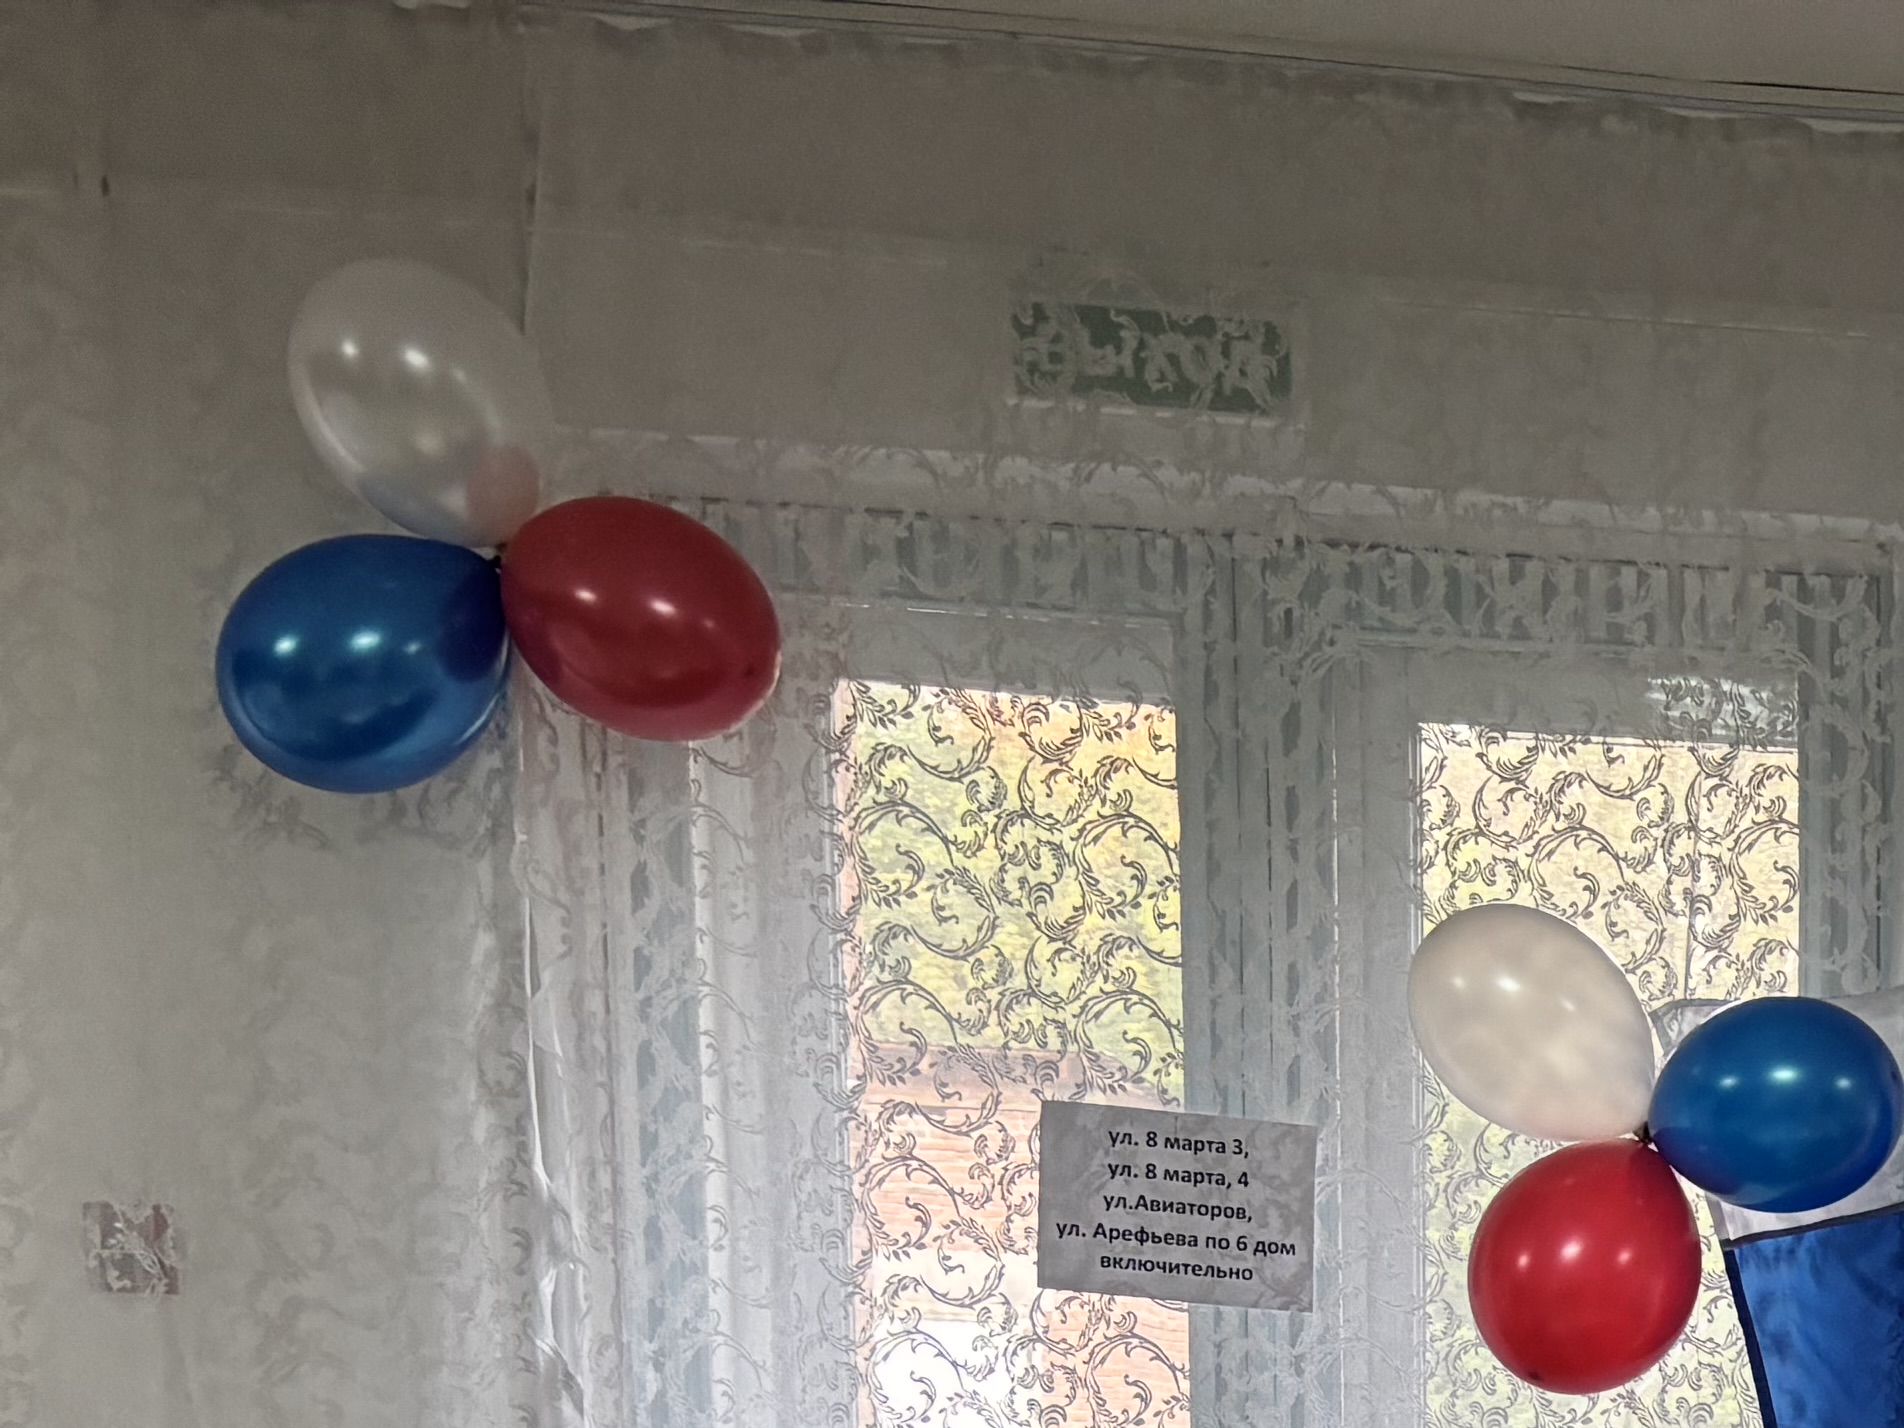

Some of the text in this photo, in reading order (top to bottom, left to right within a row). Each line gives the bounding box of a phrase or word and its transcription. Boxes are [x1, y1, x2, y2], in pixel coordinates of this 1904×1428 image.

[1108, 1130, 1249, 1158] ул. 8 марта 3,
[1108, 1162, 1249, 1190] ул. 8 марта, 4
[1103, 1194, 1252, 1223] ул.Авиаторов,
[1056, 1222, 1296, 1257] ул. Арефьева по 6 дом
[1100, 1255, 1253, 1281] включительно
